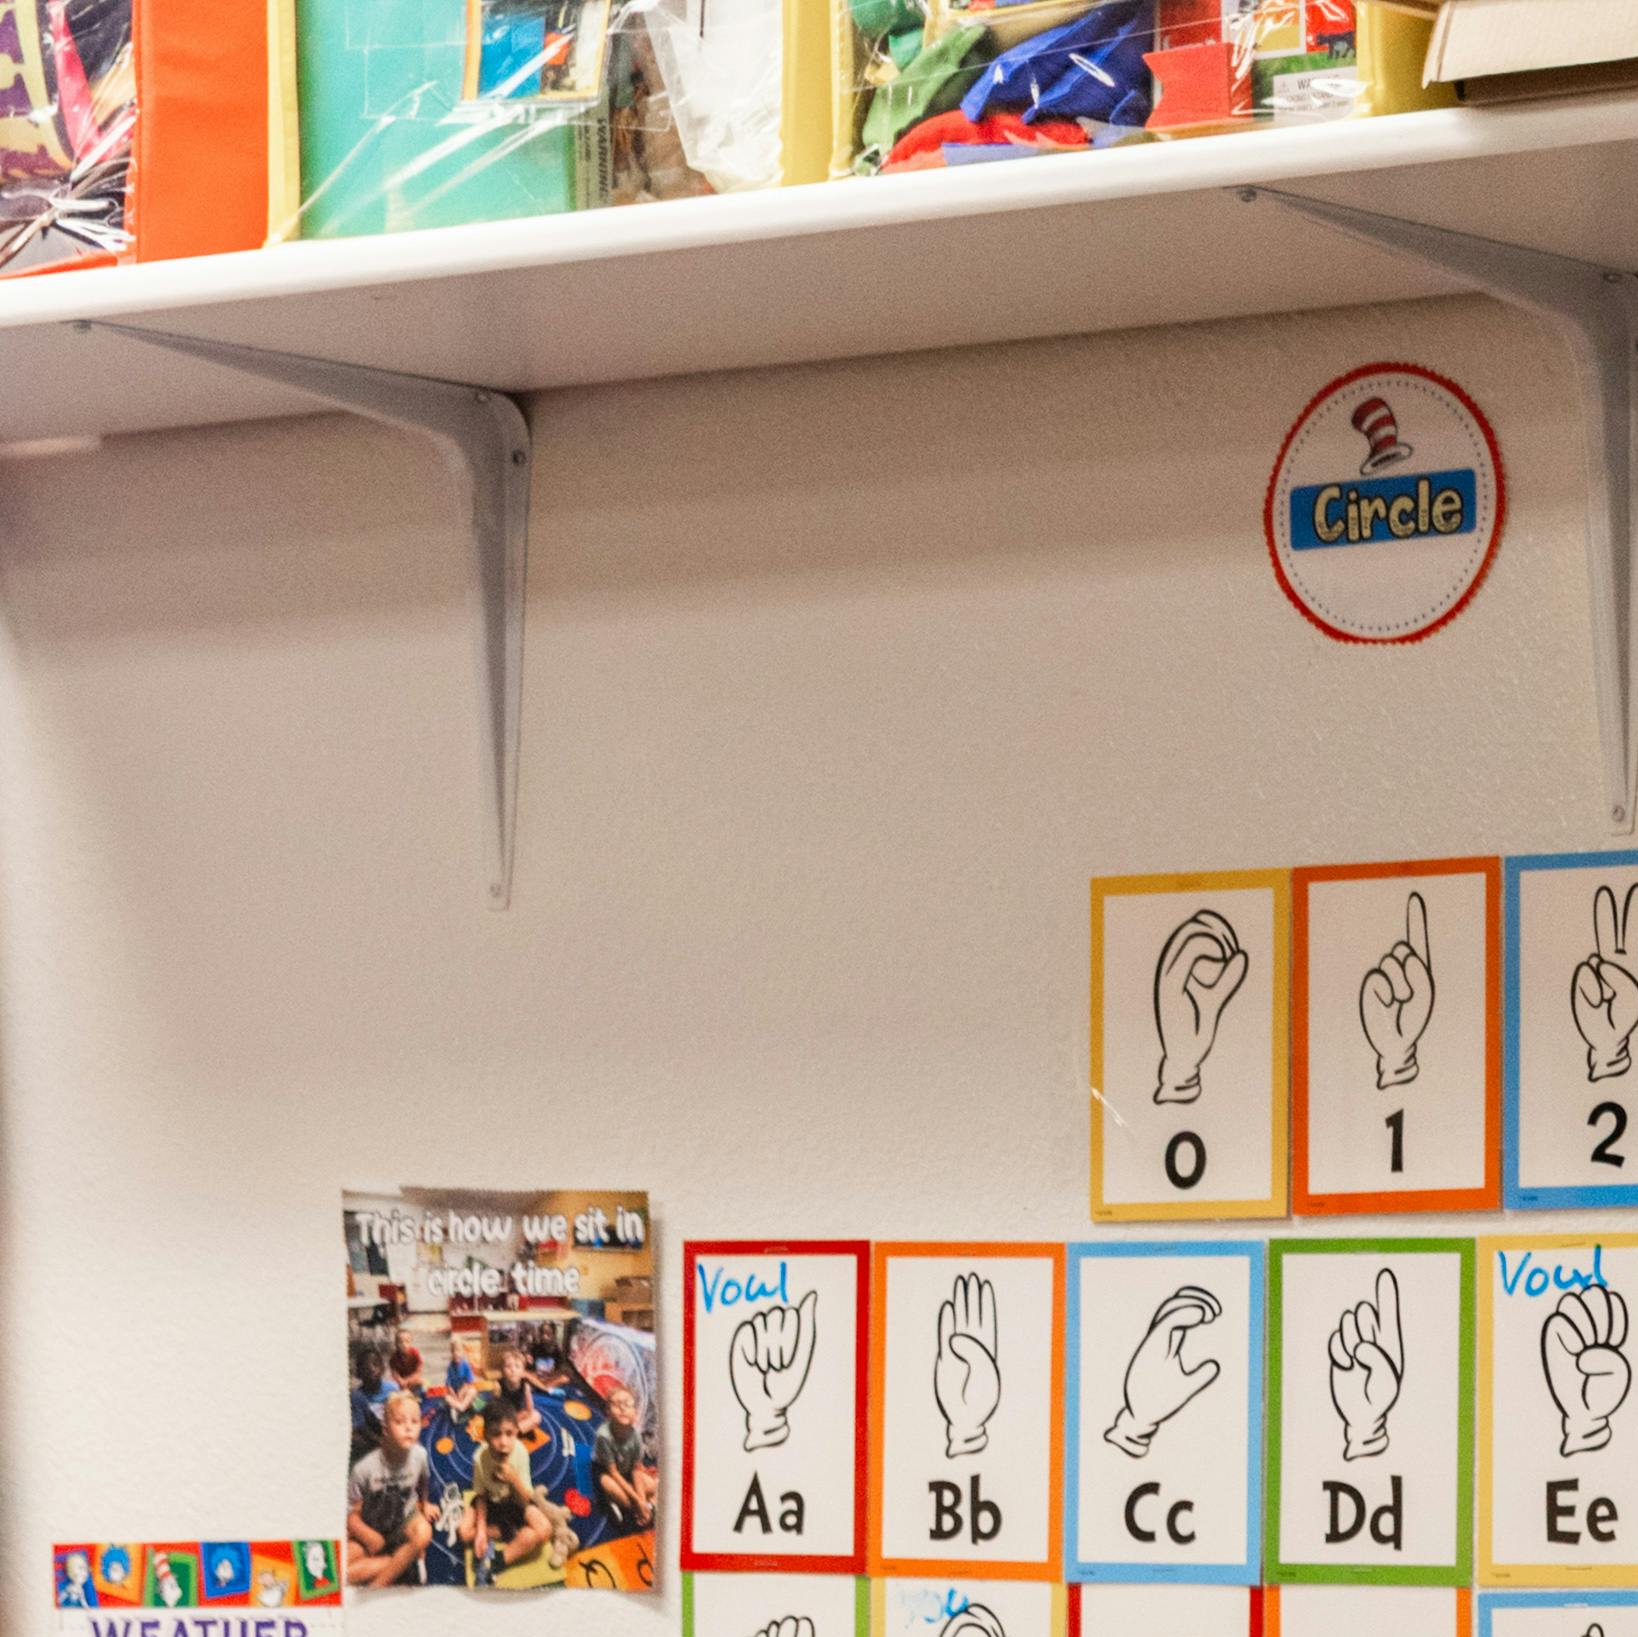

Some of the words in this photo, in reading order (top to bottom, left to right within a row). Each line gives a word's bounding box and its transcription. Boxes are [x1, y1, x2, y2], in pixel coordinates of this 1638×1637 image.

[1313, 476, 1464, 544] Circle
[1165, 1131, 1206, 1189] 0
[1386, 1109, 1403, 1172] 1
[1588, 1102, 1627, 1167] 2
[356, 1209, 414, 1245] This
[423, 1213, 445, 1244] is
[449, 1207, 512, 1243] how
[522, 1216, 568, 1243] we
[574, 1206, 608, 1243] sit
[616, 1205, 645, 1242] in
[427, 1262, 501, 1298] circle
[514, 1264, 580, 1296] time
[733, 1472, 804, 1534] Aa
[929, 1474, 1001, 1544] Bb
[1125, 1482, 1195, 1544] Cc
[1323, 1475, 1402, 1550] Dd
[1546, 1478, 1618, 1544] Ee
